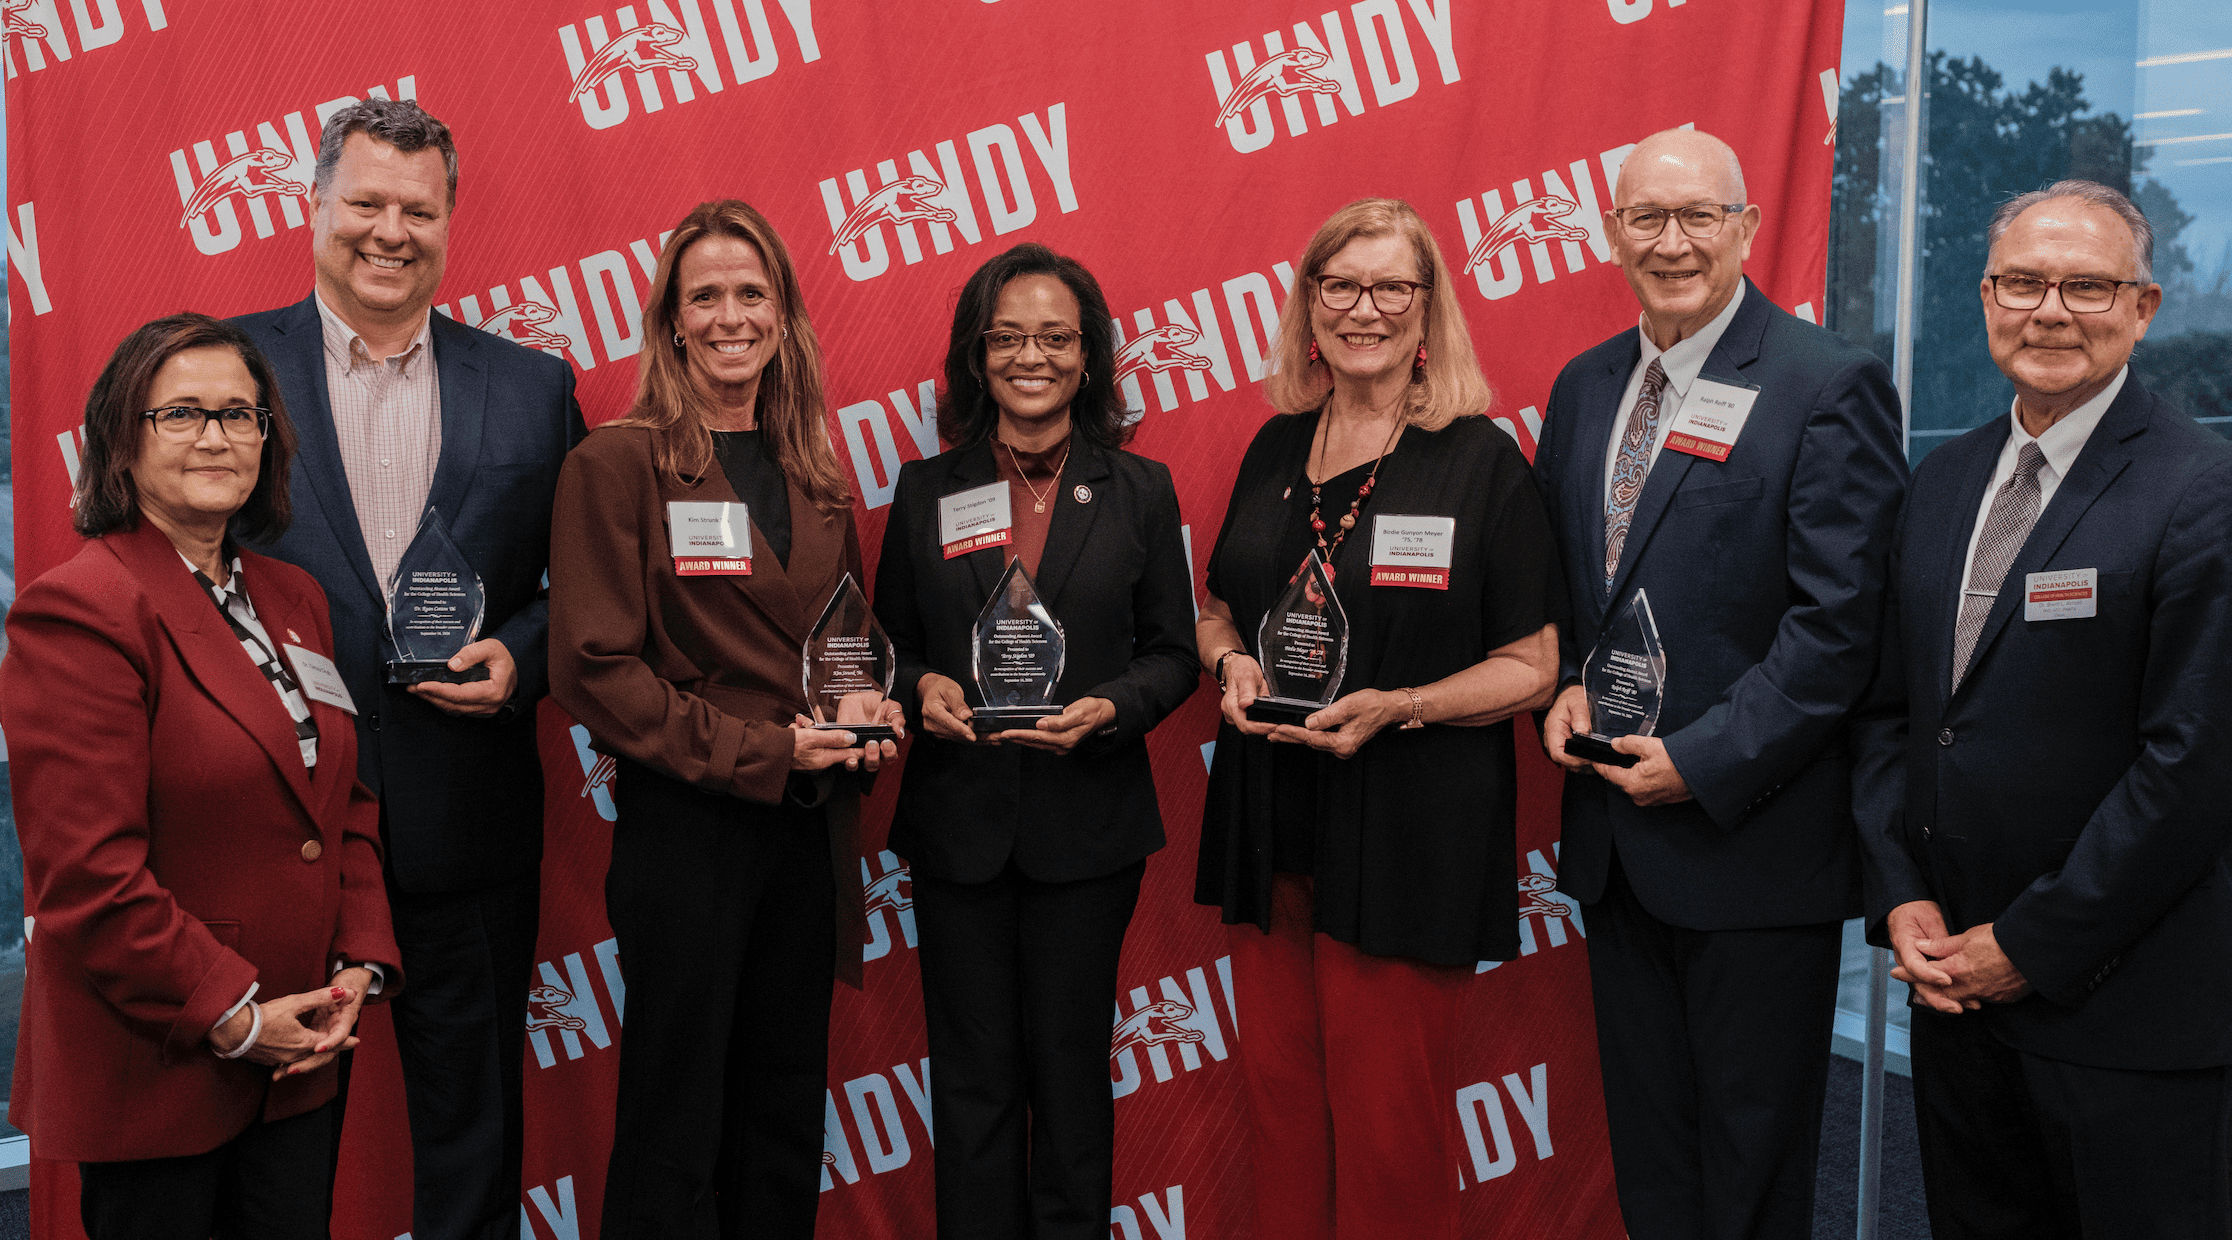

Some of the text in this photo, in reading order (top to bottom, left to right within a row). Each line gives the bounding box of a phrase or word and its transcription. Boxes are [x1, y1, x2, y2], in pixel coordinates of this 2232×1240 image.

[1206, 0, 1461, 154] UINDY
[819, 102, 1079, 282] UINDY
[1700, 396, 1714, 404] Ralph
[1714, 399, 1727, 407] Reiff
[1688, 419, 1726, 432] INDIANAPOLIS
[1690, 413, 1723, 426] UNIVERSITY
[1669, 435, 1727, 457] AWARD WINNER
[967, 500, 986, 509] Stigdon
[955, 514, 989, 527] UNIVERSITY
[955, 517, 996, 532] INDIANAPOLIS
[946, 531, 1007, 555] AWARD WINNER
[679, 561, 746, 571] AWARD WINNER
[1375, 572, 1443, 584] AWARD WINNER
[2033, 572, 2081, 583] UNIVERSITY
[2033, 579, 2089, 590] INDIANAPOLIS
[1286, 612, 1322, 621] UNIVERSITY
[1286, 618, 1327, 628] INDIANAPOLIS
[1611, 649, 1643, 661] UNIVERSITY
[1610, 655, 1647, 668] INDIANAPOLIS
